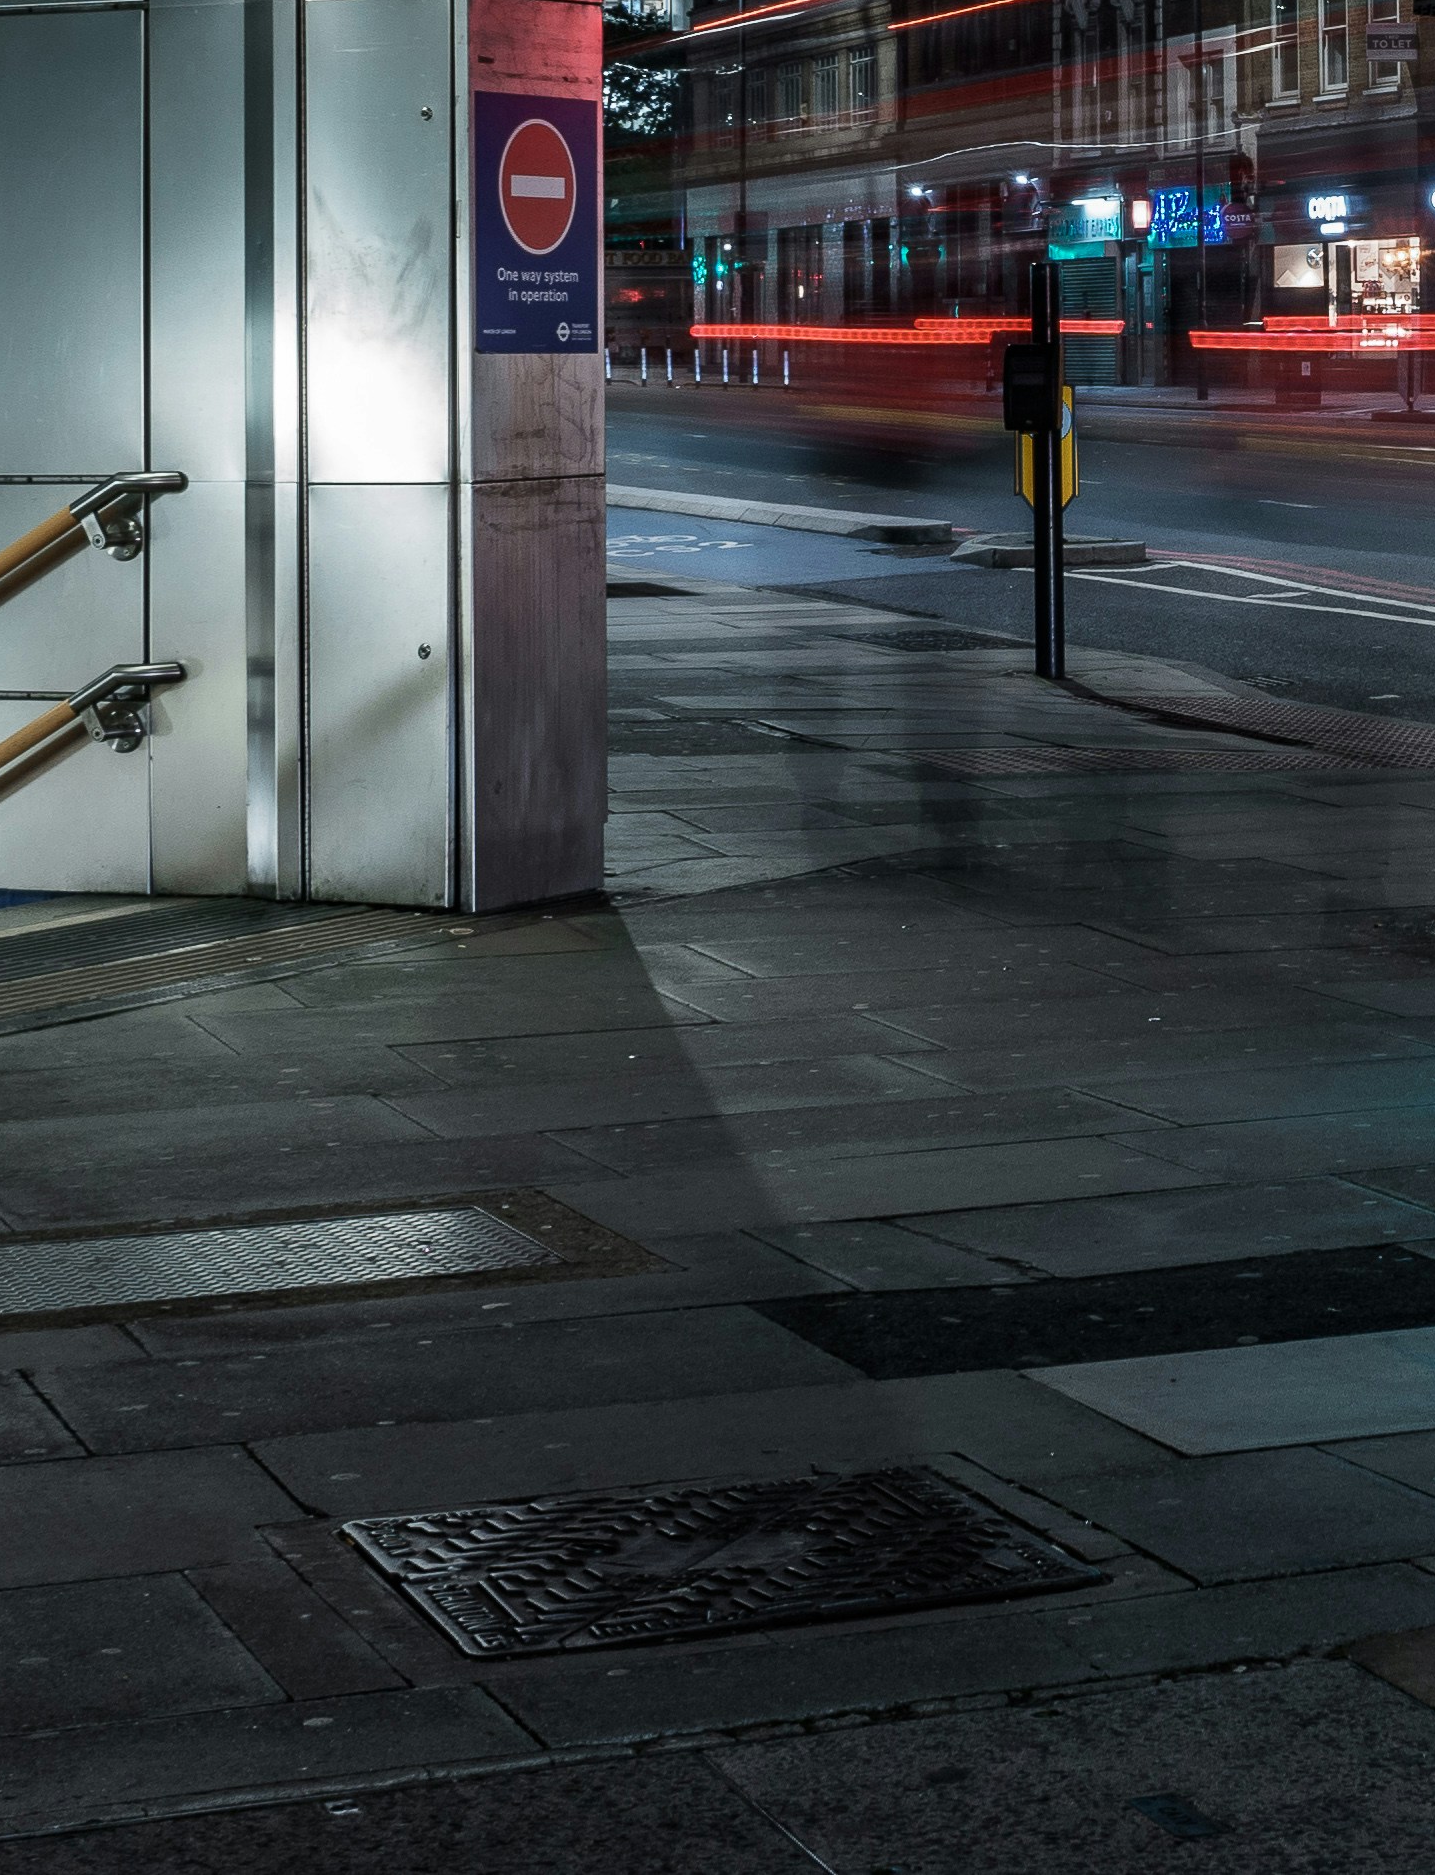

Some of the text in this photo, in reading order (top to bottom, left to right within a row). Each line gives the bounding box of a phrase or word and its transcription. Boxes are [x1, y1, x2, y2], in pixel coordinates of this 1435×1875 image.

[1372, 39, 1412, 49] TO LET
[1308, 195, 1347, 221] COSTA
[1224, 214, 1252, 224] COSTA
[622, 252, 663, 265] FOOD
[497, 267, 579, 285] One way system
[508, 287, 569, 304] in operation
